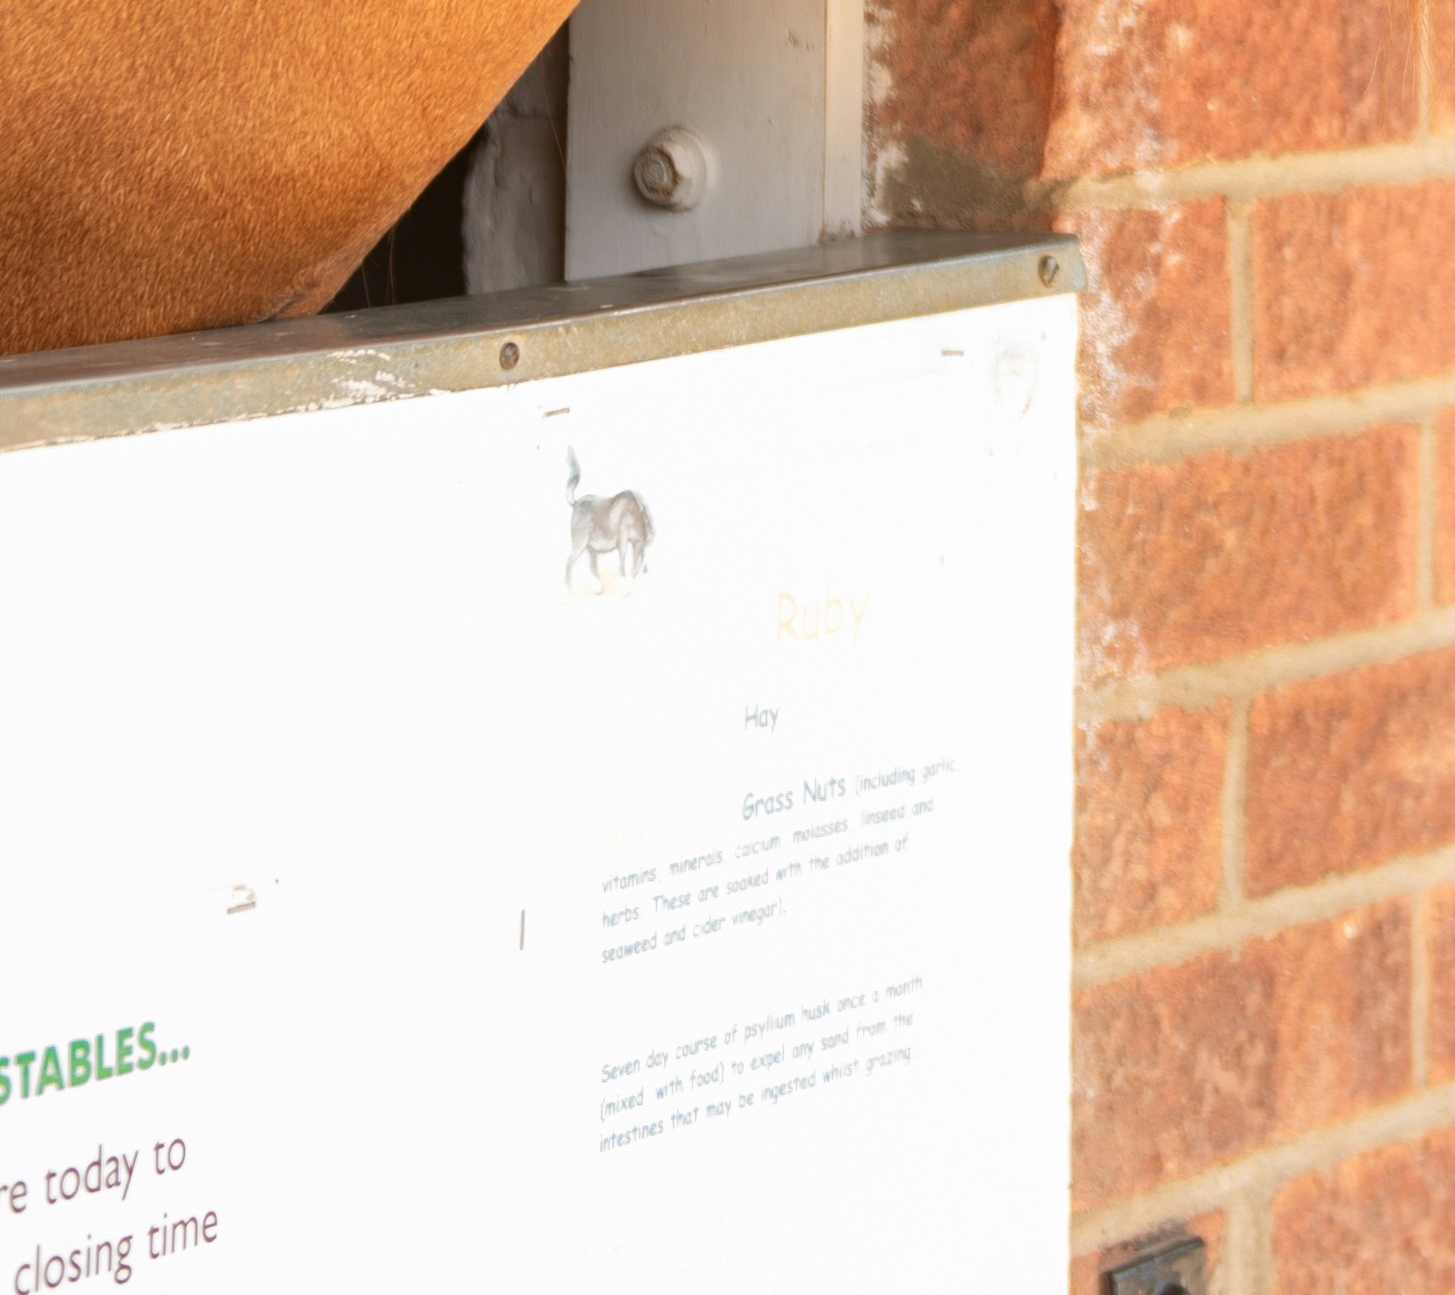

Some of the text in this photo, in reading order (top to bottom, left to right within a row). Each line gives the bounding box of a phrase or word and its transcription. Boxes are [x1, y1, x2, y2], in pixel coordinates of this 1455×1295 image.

[774, 586, 871, 647] Ruby
[744, 703, 781, 734] Hay
[741, 790, 795, 822] Grass
[802, 776, 847, 806] Nuts
[911, 797, 935, 816] and
[651, 892, 692, 914] These
[697, 884, 720, 904] are
[725, 866, 769, 896] soaked
[774, 861, 802, 883] with
[808, 854, 830, 872] the
[836, 840, 889, 866] addition
[894, 831, 910, 852] of
[601, 930, 658, 965] seaweed
[663, 925, 687, 947] and
[692, 913, 726, 938] cider
[599, 1058, 641, 1084] Seven
[645, 1048, 670, 1070] day
[675, 1034, 718, 1060] course
[723, 1023, 738, 1046] of
[836, 993, 866, 1013] once
[871, 989, 880, 1004] a
[885, 975, 923, 1000] month
[599, 1010, 914, 1124] (mixed with food) to expel any sand from the
[599, 1119, 664, 1153] intestines
[669, 1105, 700, 1130] that
[705, 1100, 732, 1119] may
[738, 1091, 754, 1109] be
[760, 1067, 817, 1105] ingested
[44, 1143, 140, 1205] today
[153, 1137, 187, 1176] to
[13, 1232, 135, 1295] closing
[147, 1210, 219, 1260] time
